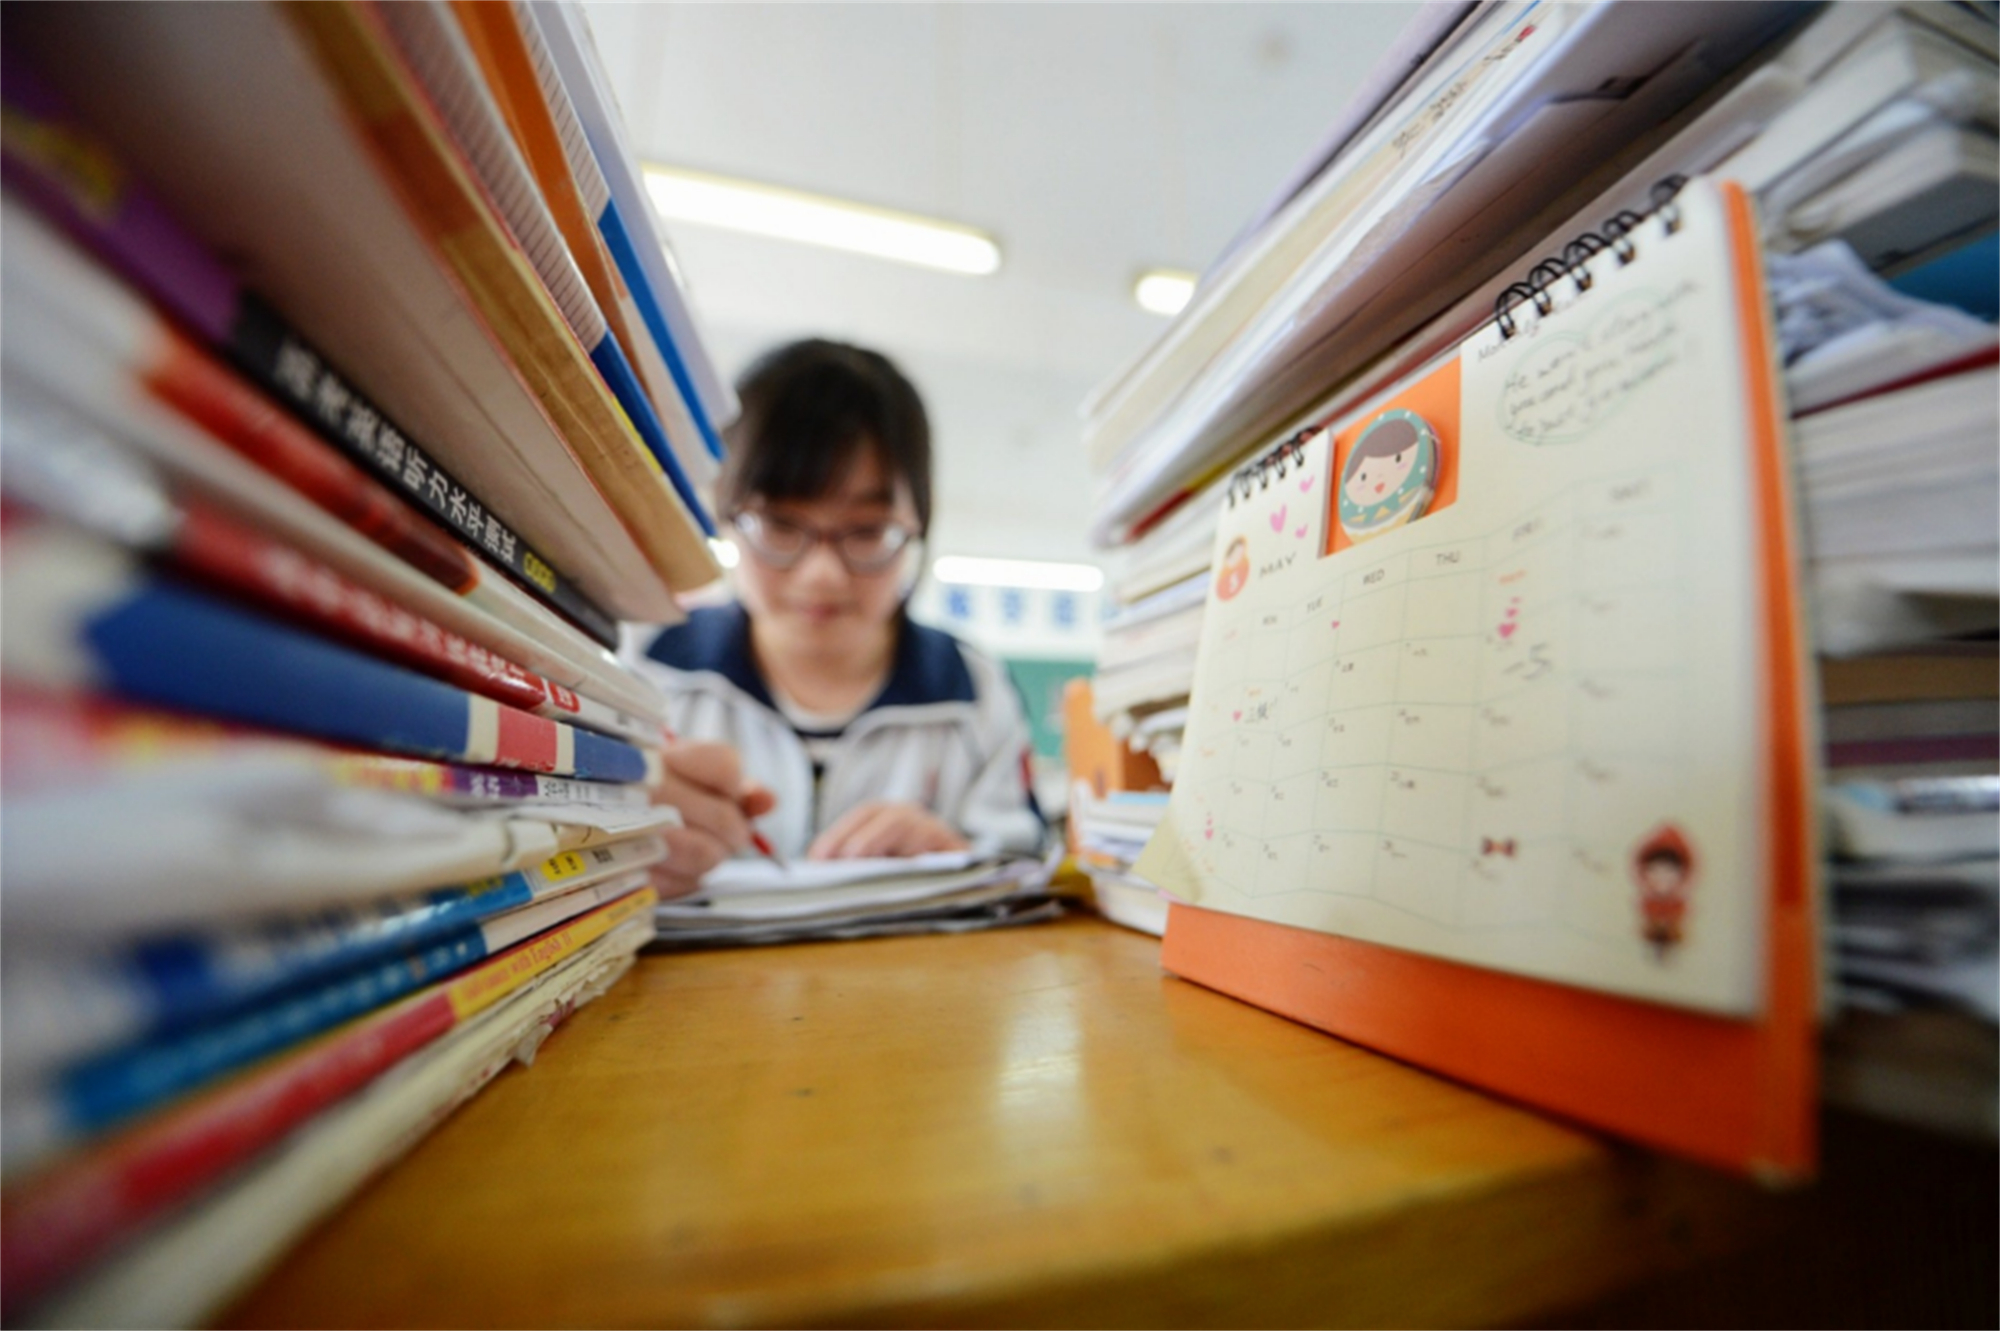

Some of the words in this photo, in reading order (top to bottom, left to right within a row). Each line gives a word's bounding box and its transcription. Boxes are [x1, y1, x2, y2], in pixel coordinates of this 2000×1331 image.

[1260, 551, 1297, 578] MAY
[1362, 568, 1386, 585] WED
[1435, 550, 1462, 566] THU
